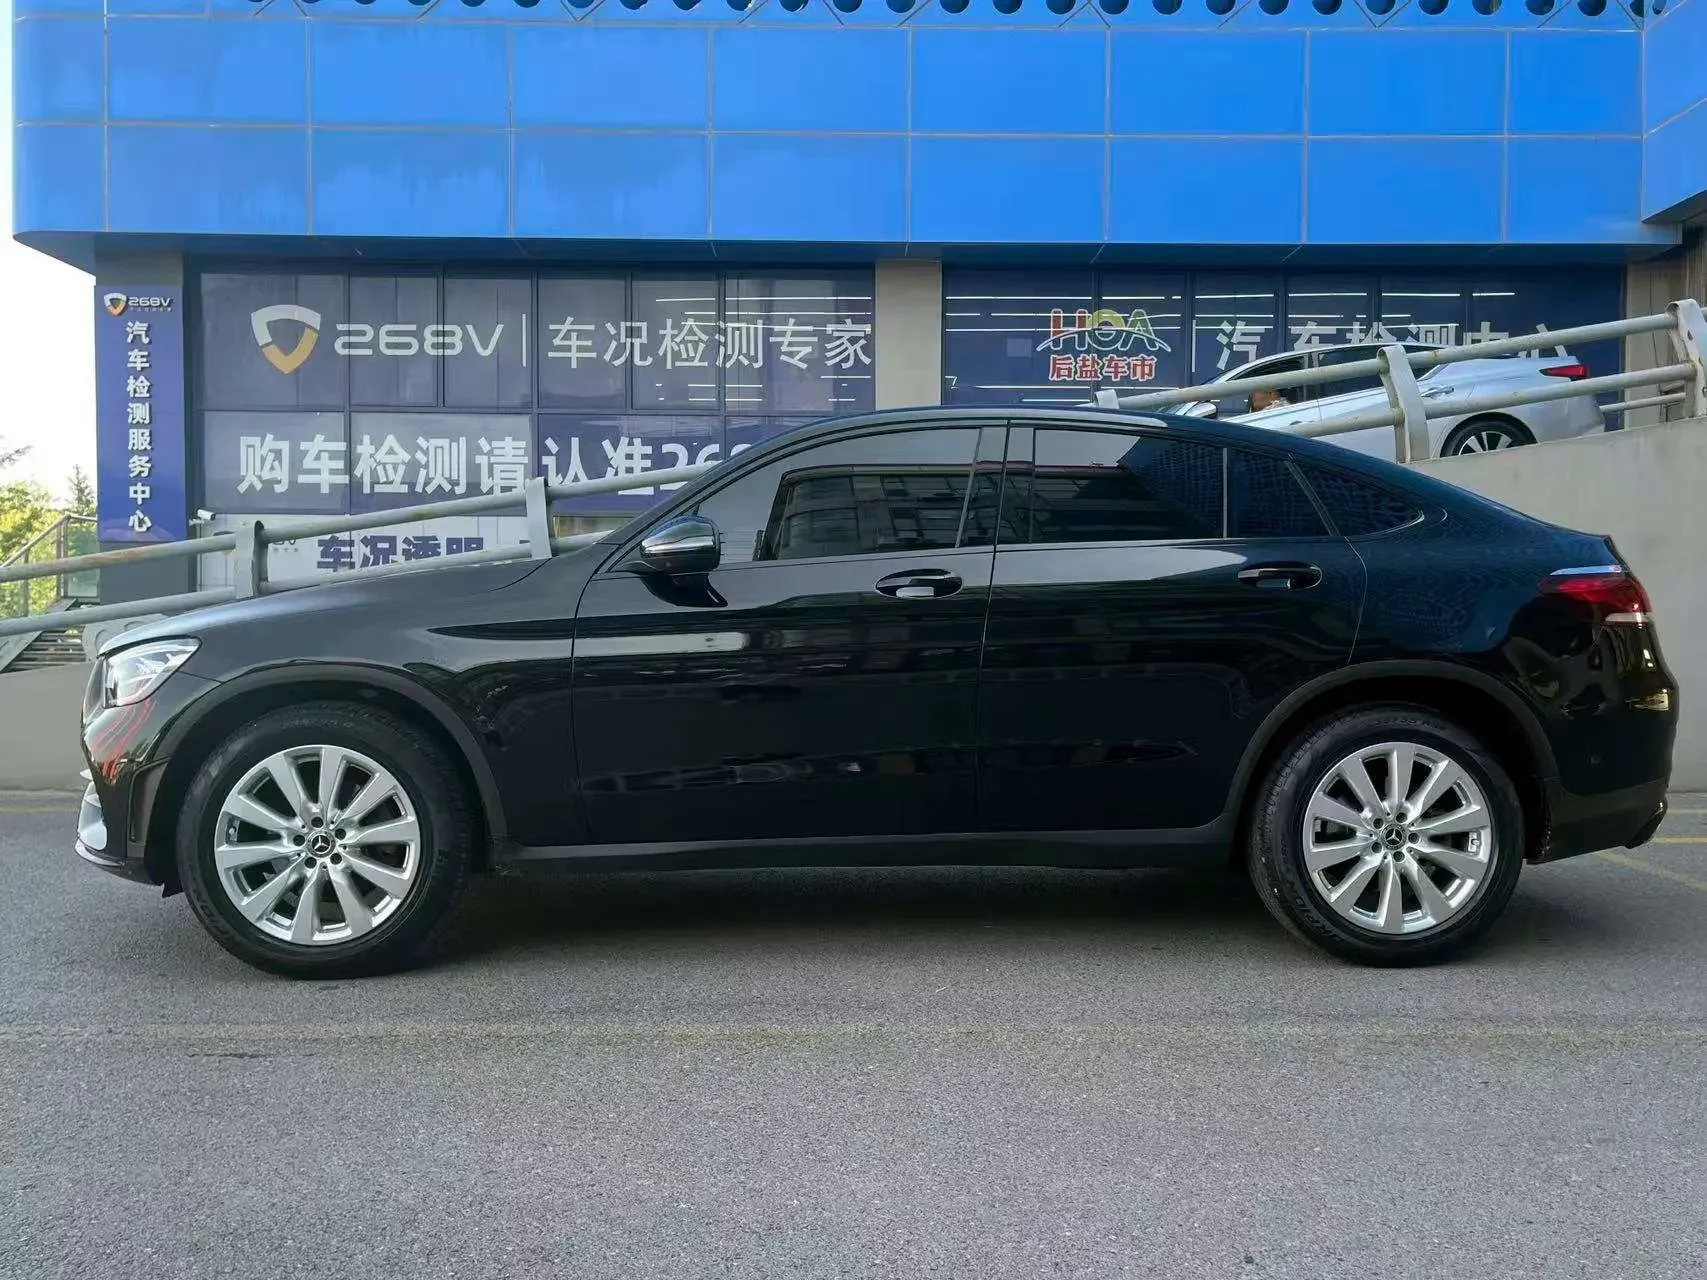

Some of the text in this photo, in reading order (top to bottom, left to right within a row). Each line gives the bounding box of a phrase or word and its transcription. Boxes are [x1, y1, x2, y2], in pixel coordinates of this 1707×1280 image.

[128, 296, 171, 307] 268V
[334, 315, 872, 370] 268V 车况检测专家
[1050, 308, 1160, 351] HOA
[1048, 353, 1157, 382] 后盐车市
[126, 321, 152, 533] 汽车检测服务中心
[236, 432, 751, 496] 购车检测请认准2
